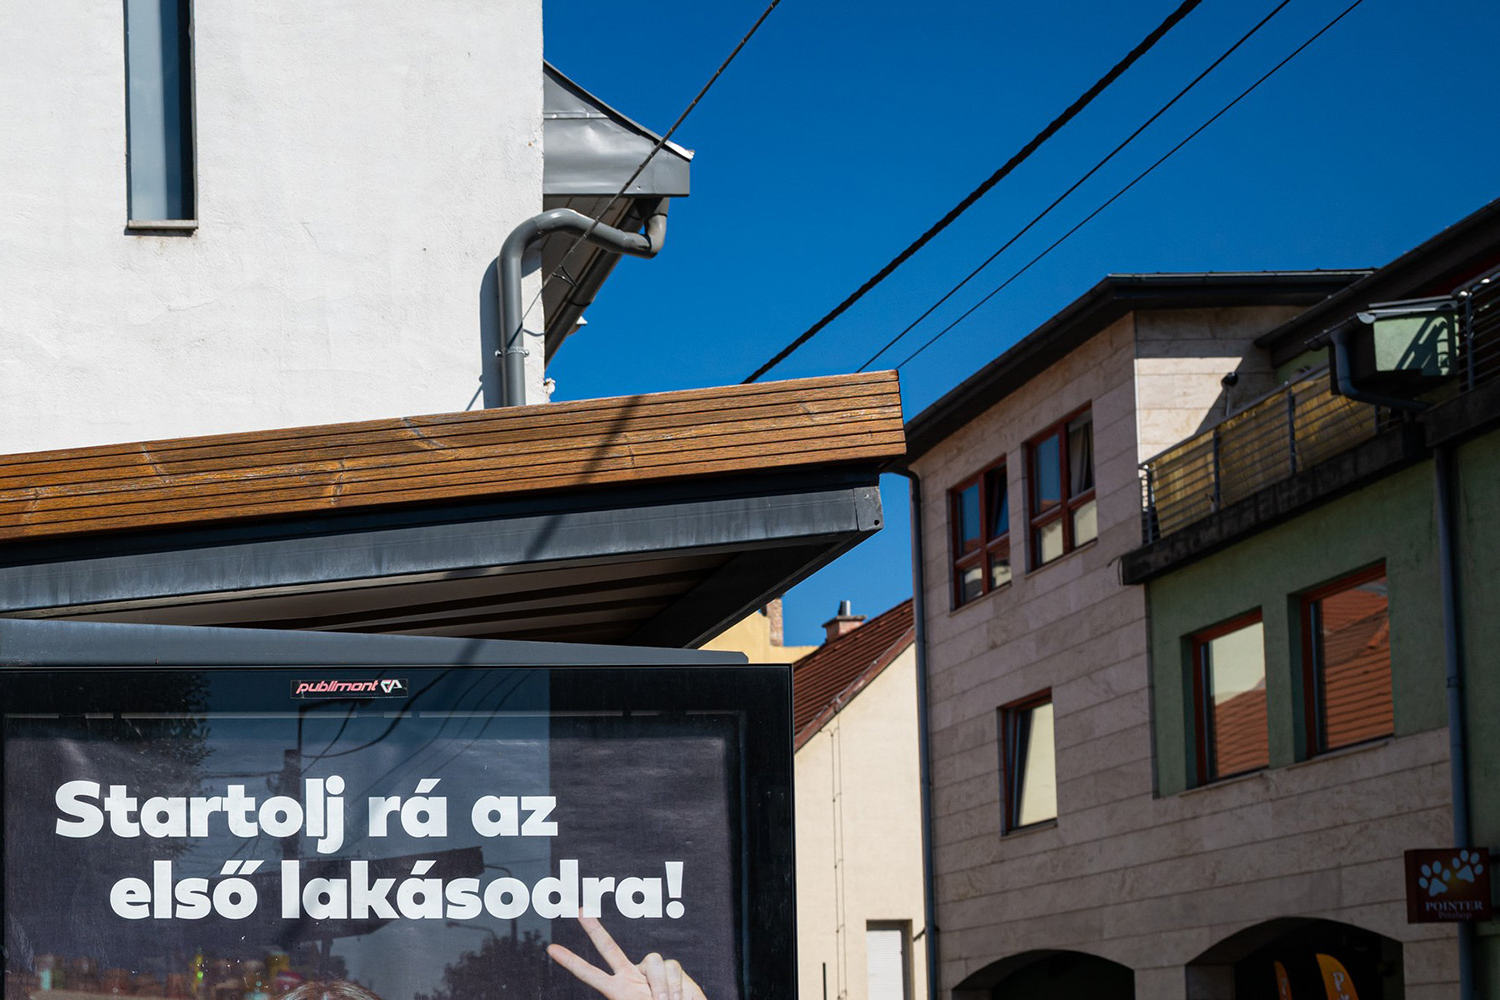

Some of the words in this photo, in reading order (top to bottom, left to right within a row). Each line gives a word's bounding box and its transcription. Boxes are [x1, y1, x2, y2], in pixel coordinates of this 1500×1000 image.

[295, 680, 379, 695] publimont
[54, 774, 346, 855] Startolj
[368, 778, 448, 838] rá
[471, 795, 559, 838] az
[109, 859, 259, 920] első
[280, 859, 685, 920] lakásodra!
[1424, 900, 1485, 913] POINTER
